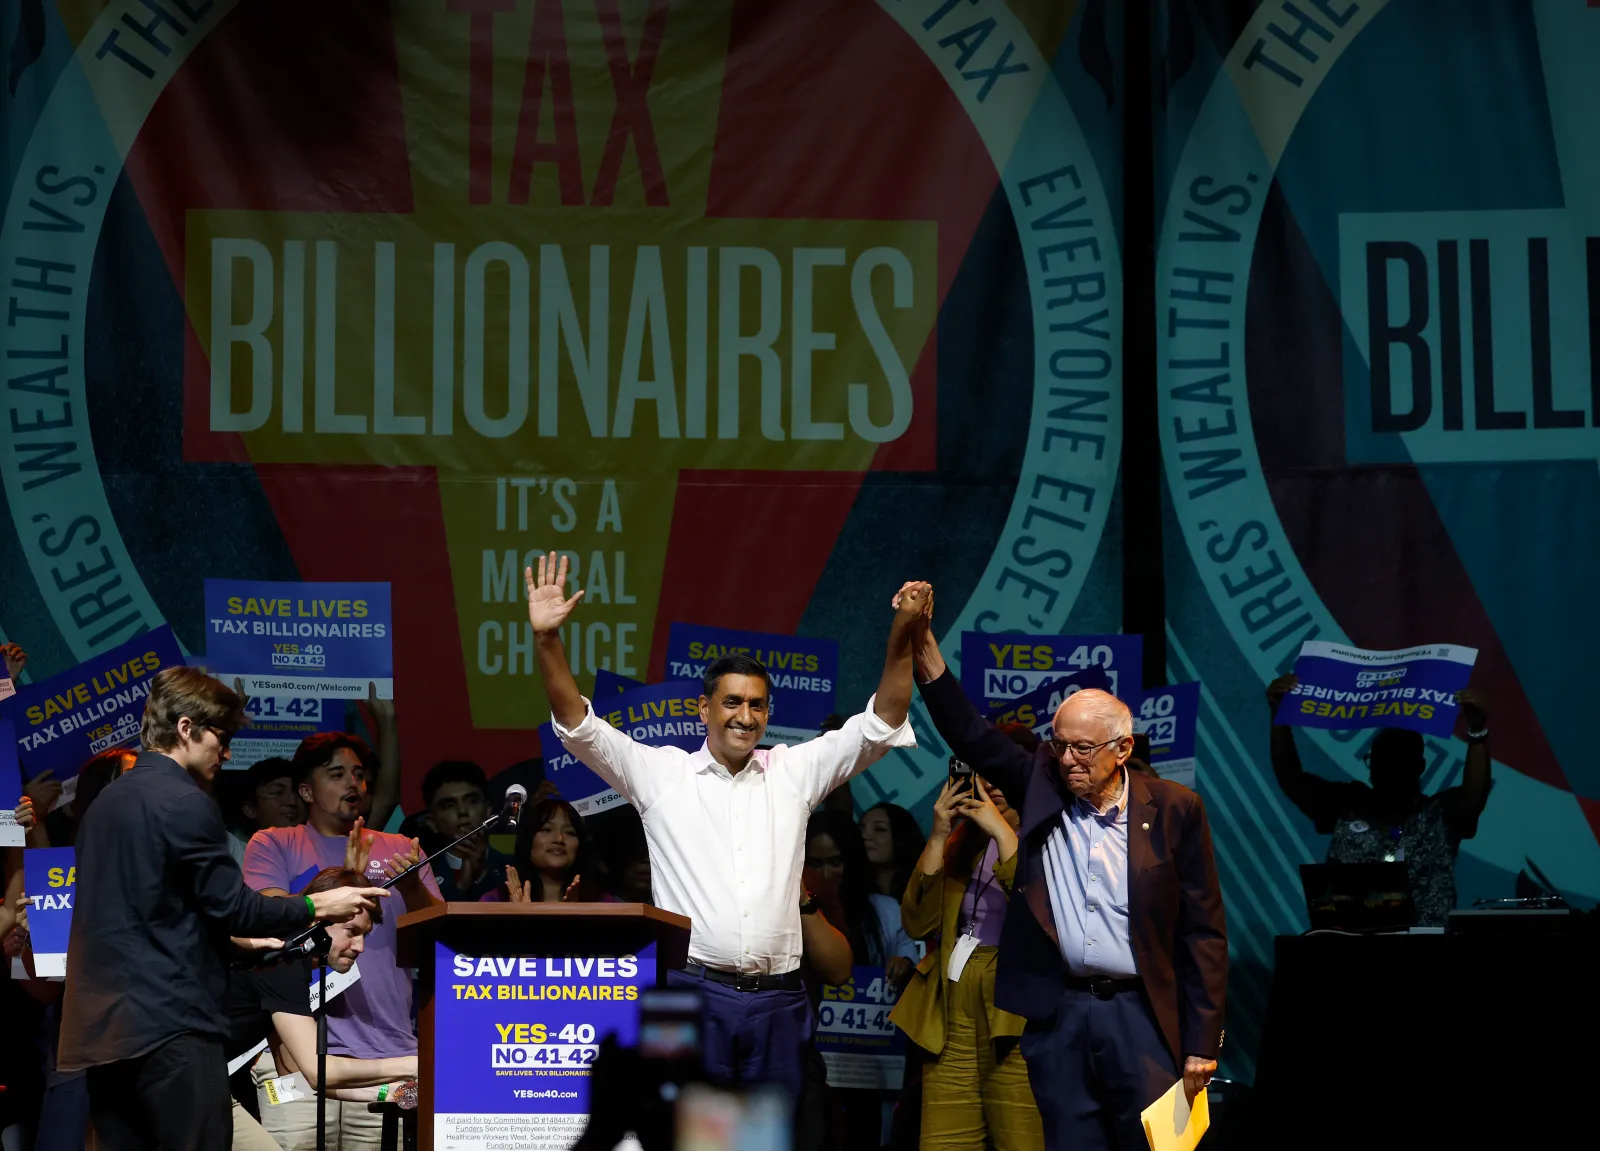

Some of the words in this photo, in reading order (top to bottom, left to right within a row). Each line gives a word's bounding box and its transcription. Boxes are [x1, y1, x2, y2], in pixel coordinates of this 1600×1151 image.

[446, 0, 669, 207] TAX
[22, 165, 105, 233] VS.
[1178, 172, 1258, 241] VS.
[1018, 164, 1112, 460] EVERYONE
[209, 237, 915, 443] BILLIONAIRES
[7, 257, 83, 491] WEALTH
[1168, 267, 1248, 500] WEALTH
[496, 477, 578, 533] IT'S
[596, 478, 623, 533] A
[32, 512, 150, 648] IRES'
[227, 596, 292, 617] SAVE
[297, 599, 369, 618] LIVES
[210, 619, 249, 635] TAX
[252, 621, 386, 638] BILLIONAIRES
[273, 643, 299, 655] YES
[304, 644, 323, 655] 40
[477, 620, 637, 676] CHICE
[989, 643, 1054, 670] YES
[1068, 645, 1113, 670] 40
[273, 655, 290, 664] NO
[293, 656, 307, 665] 41
[310, 656, 324, 665] 42
[756, 649, 819, 672] LIVES
[25, 682, 92, 725] SAVE
[92, 650, 161, 696] LIVES
[251, 680, 362, 693] YESon40.com/Welcome
[670, 661, 705, 678] TAX
[769, 673, 832, 693] NAIRES
[989, 674, 1028, 695] NO
[1290, 683, 1416, 703] BILLIONAIRES
[1418, 687, 1457, 707] TAX
[18, 724, 60, 752] TAX
[59, 677, 154, 735] BILLIONAI
[245, 697, 279, 716] 41
[286, 698, 319, 717] 42
[628, 698, 699, 724] LIVES
[996, 704, 1037, 728] ES
[1140, 694, 1175, 719] 40
[1300, 699, 1368, 719] LIVES
[1372, 702, 1437, 720] SAVE
[86, 723, 113, 742] YES
[117, 713, 135, 727] 40
[91, 739, 108, 753] NO
[110, 731, 125, 743] 41
[125, 723, 140, 735] 42
[766, 731, 804, 741] Welcome
[1146, 721, 1173, 741] 42
[30, 893, 73, 911] TAX
[453, 954, 537, 977] SAVE
[546, 954, 638, 978] LIVES
[452, 985, 493, 1000] TAX
[497, 985, 639, 1001] BILLIONAIRES
[823, 977, 856, 1001] ES
[820, 1006, 835, 1027] O
[841, 1008, 867, 1030] 41
[495, 1023, 548, 1044] YES
[558, 1023, 596, 1044] 40
[495, 1048, 527, 1064] NO
[534, 1048, 562, 1064] 41
[568, 1048, 597, 1064] 42
[455, 1125, 484, 1133] Funders
[484, 1125, 509, 1133] Service
[510, 1125, 546, 1135] Employees
[456, 1117, 472, 1126] paid
[472, 1116, 482, 1124] for
[483, 1117, 492, 1126] by
[493, 1116, 530, 1124] Committee
[446, 1133, 481, 1141] Healthcare
[482, 1133, 509, 1141] Workers
[510, 1133, 529, 1142] West,
[530, 1133, 551, 1141] Saikat
[552, 1133, 582, 1141] Chakrab
[486, 1142, 514, 1151] Funding
[514, 1142, 538, 1150] Details
[539, 1142, 547, 1150] at
